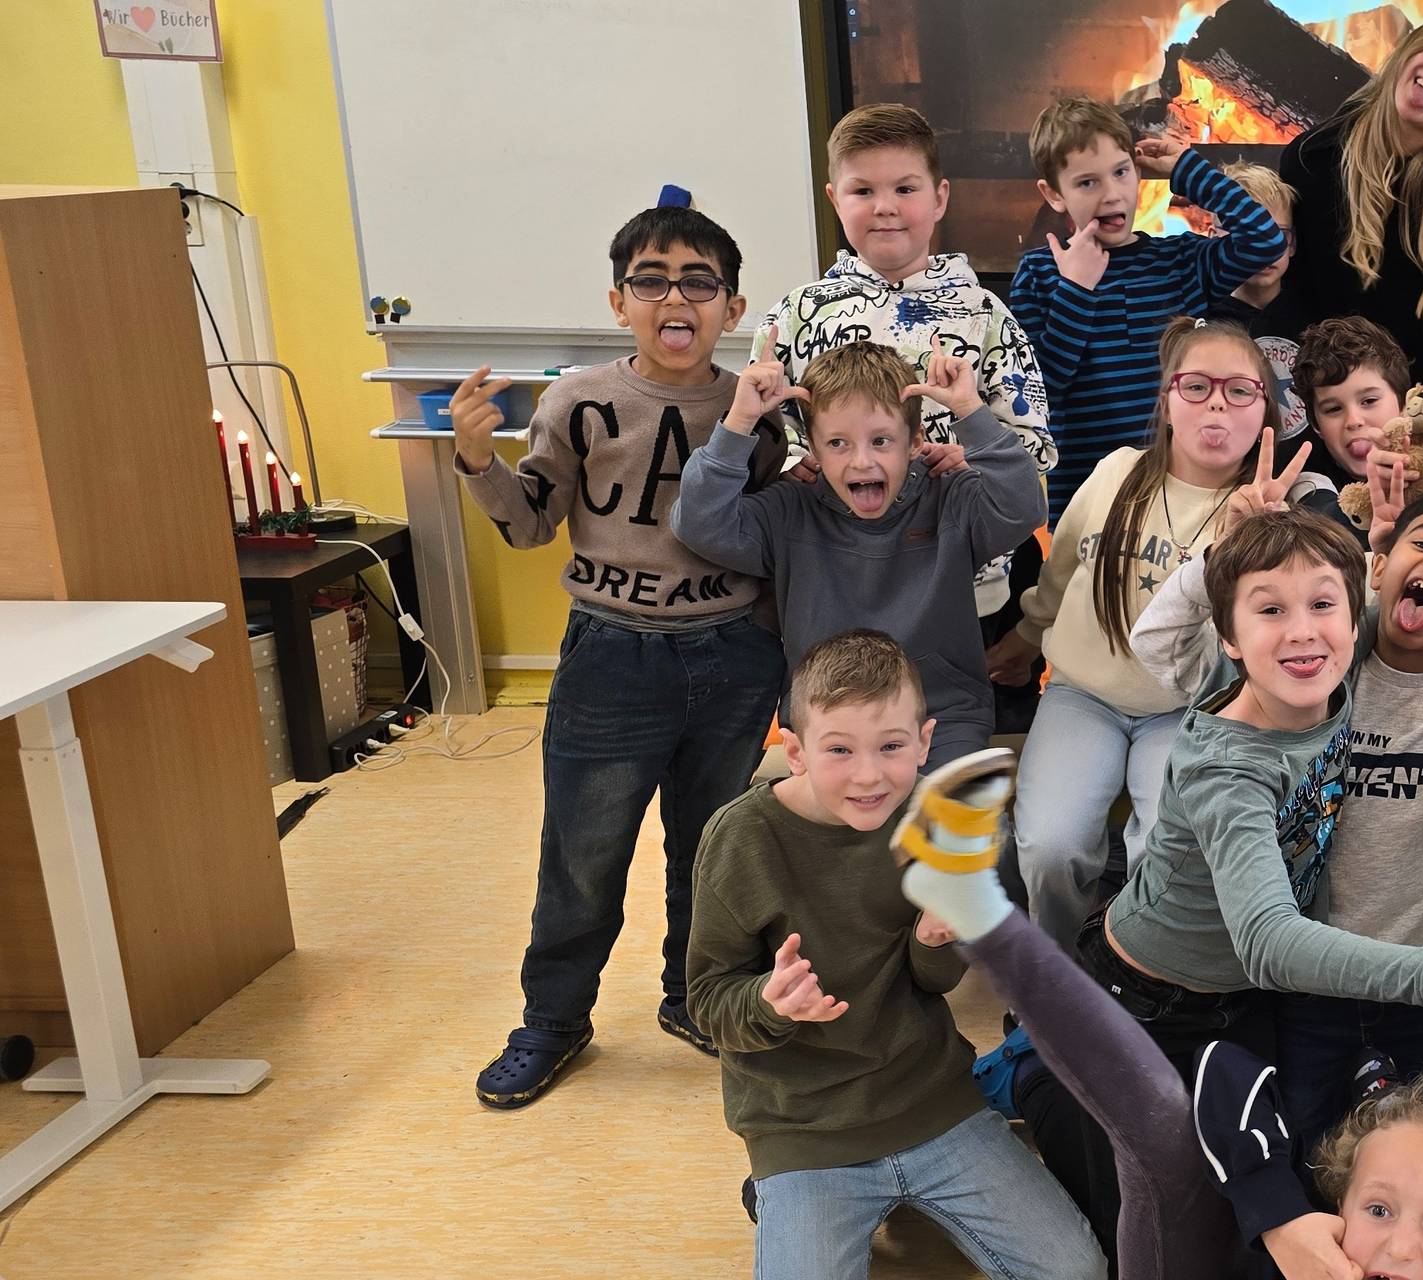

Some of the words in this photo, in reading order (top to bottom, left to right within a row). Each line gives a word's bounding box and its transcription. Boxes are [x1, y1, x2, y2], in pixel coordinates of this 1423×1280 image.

[104, 9, 130, 24] Wir
[161, 9, 210, 27] Bücher
[1284, 400, 1306, 430] ANY
[568, 552, 733, 607] DREAM
[1367, 733, 1392, 749] MY
